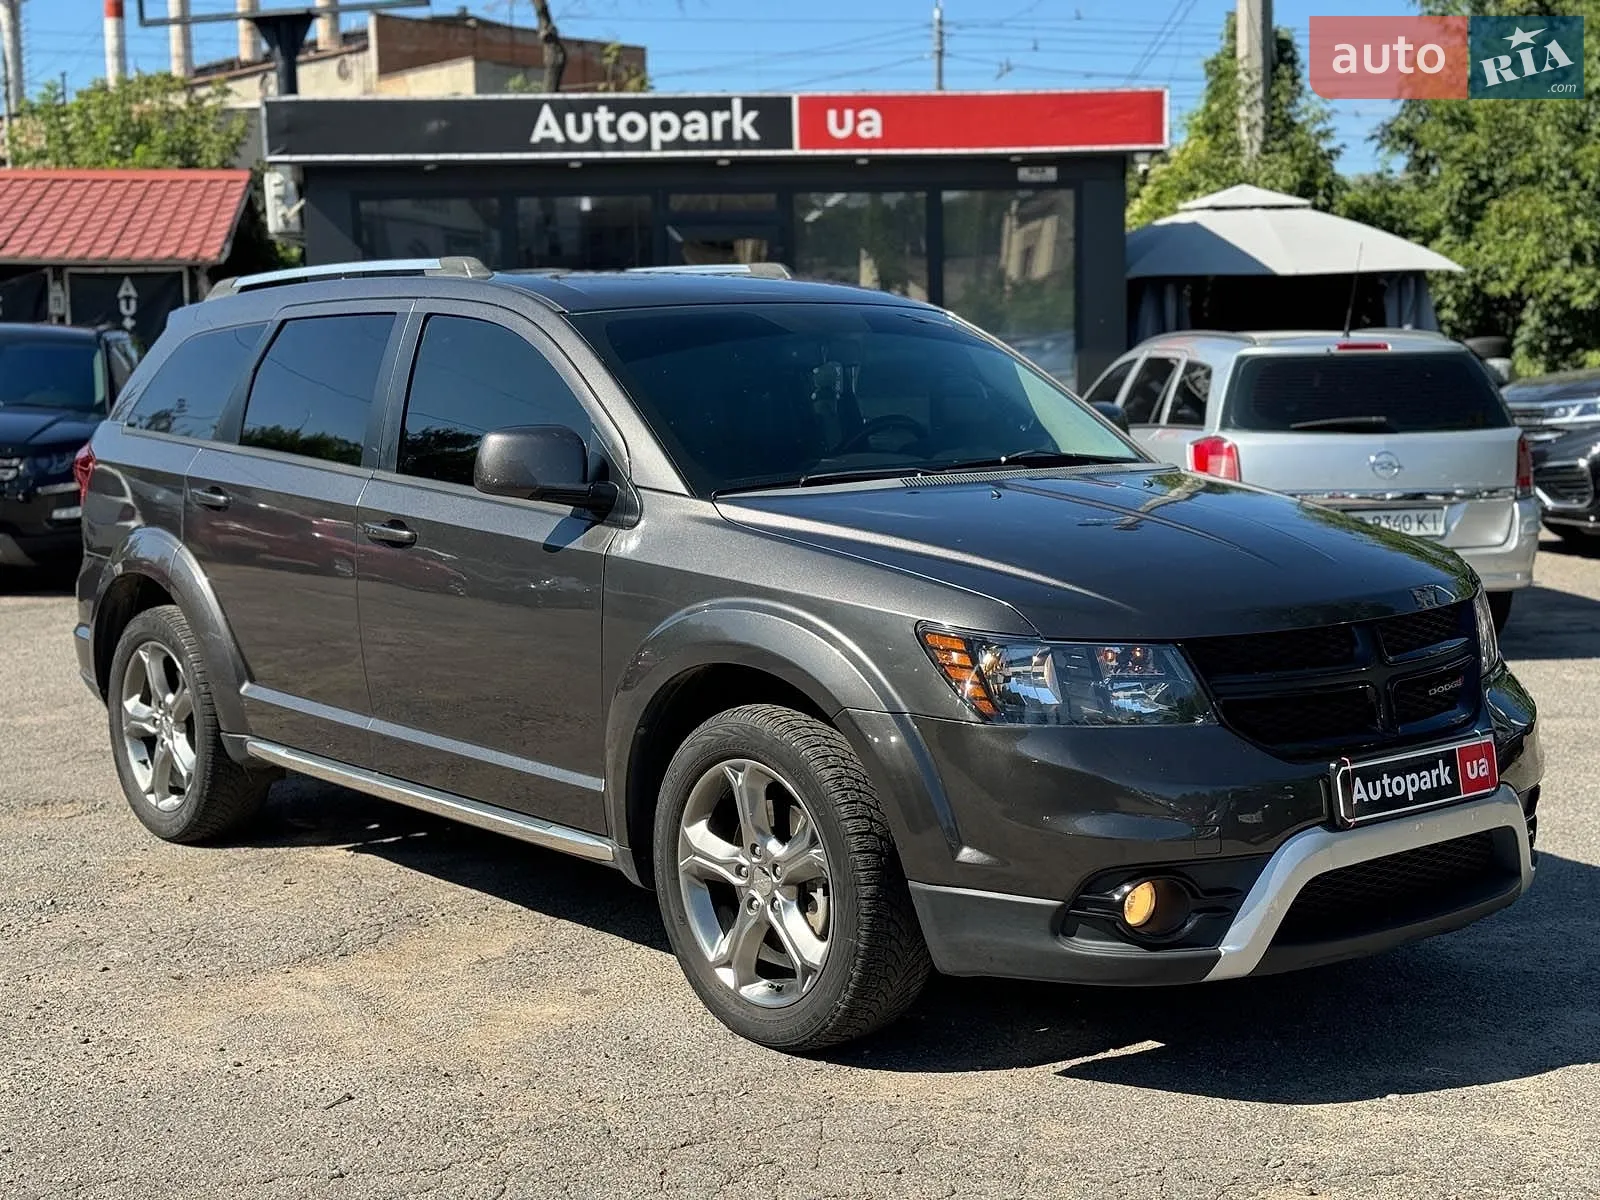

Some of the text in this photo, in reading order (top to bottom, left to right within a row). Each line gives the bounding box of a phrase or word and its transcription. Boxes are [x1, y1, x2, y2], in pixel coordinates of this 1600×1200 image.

[530, 97, 883, 150] Autopark ua
[1352, 757, 1490, 804] Autopark ua
